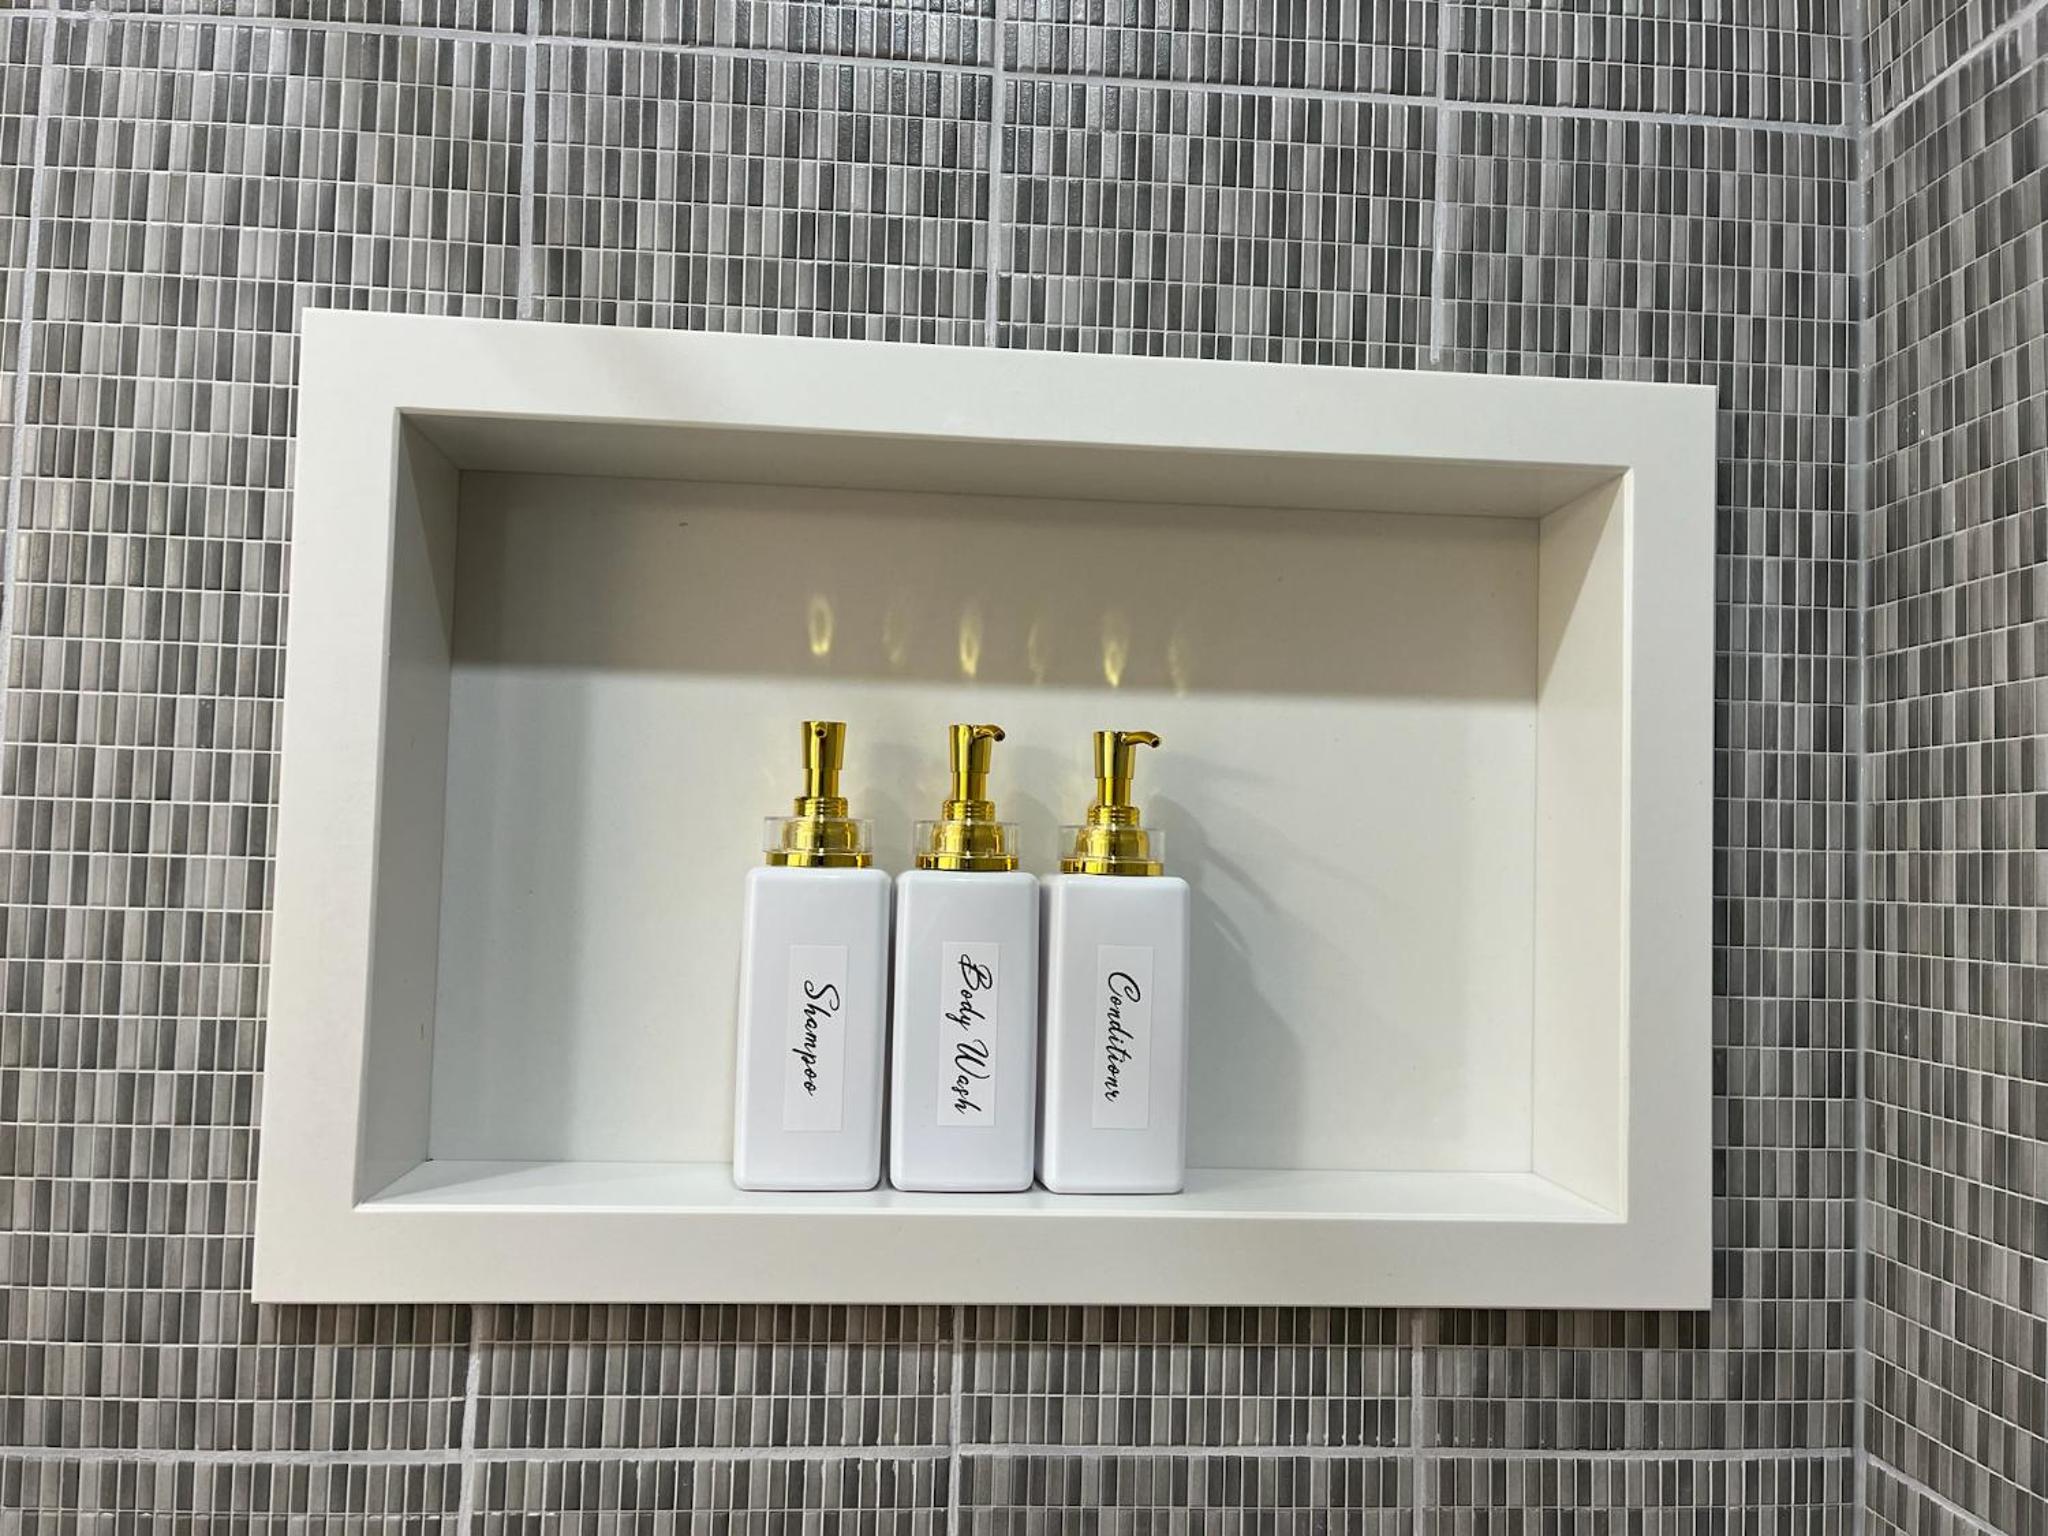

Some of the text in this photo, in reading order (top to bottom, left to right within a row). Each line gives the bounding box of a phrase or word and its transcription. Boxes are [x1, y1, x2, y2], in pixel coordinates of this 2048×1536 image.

[792, 980, 841, 1097] Shampoo
[944, 953, 993, 1115] Body Wash
[1104, 971, 1141, 1103] Conditionr
